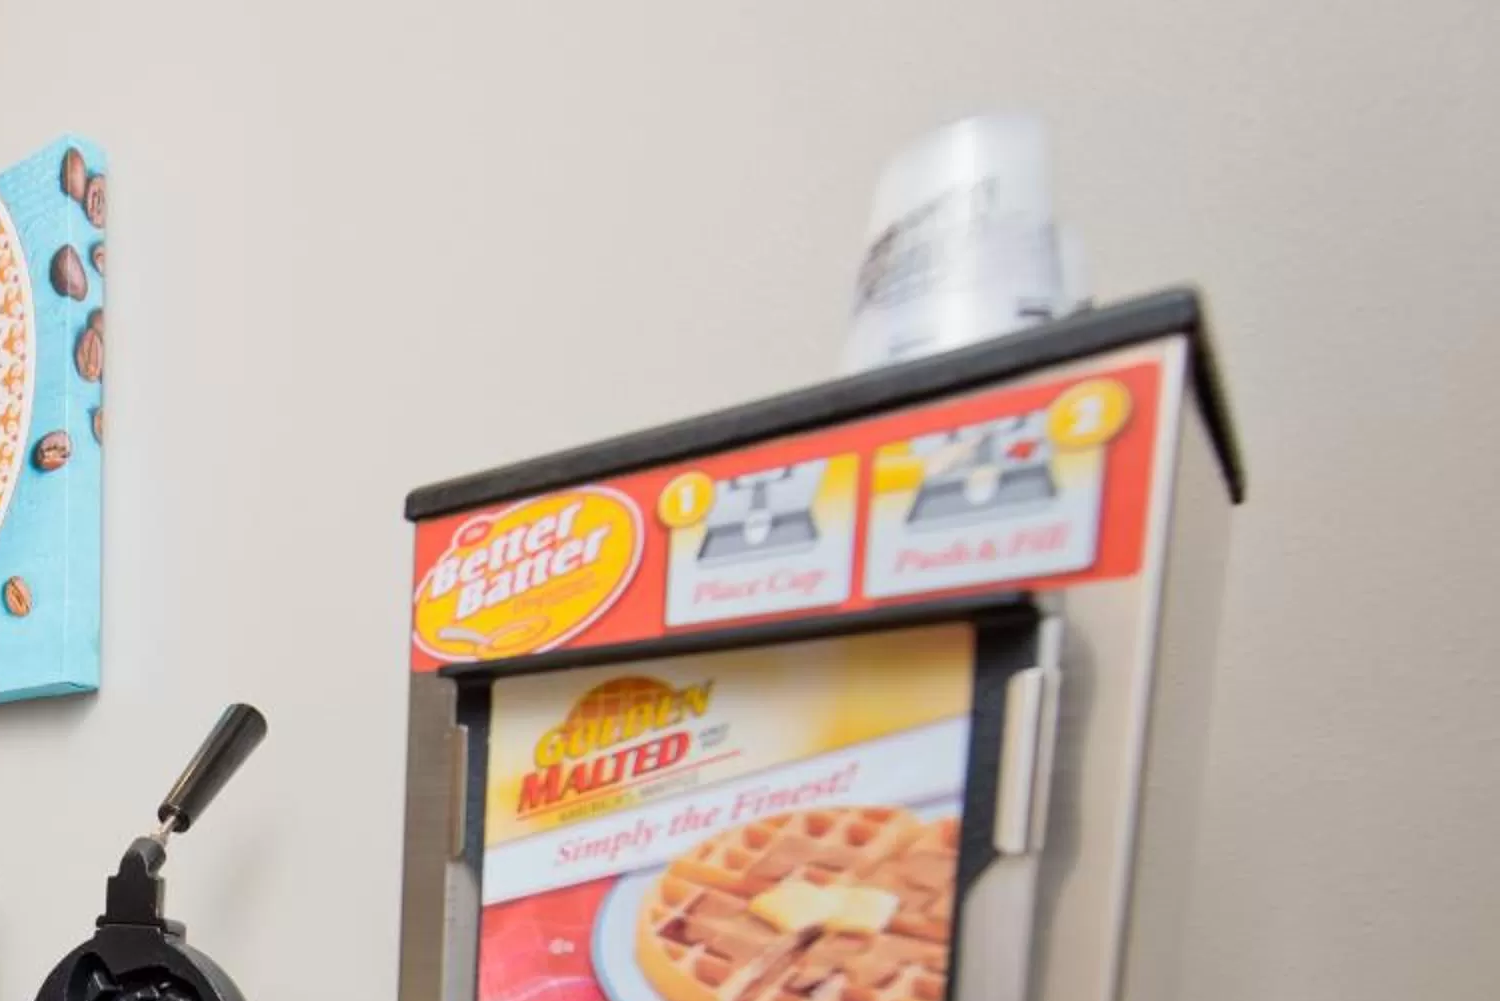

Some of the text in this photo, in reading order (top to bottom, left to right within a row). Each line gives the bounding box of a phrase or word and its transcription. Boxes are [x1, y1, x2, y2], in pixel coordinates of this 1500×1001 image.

[678, 482, 695, 516] 1
[429, 500, 584, 599] Better
[456, 524, 612, 620] Batter
[533, 675, 716, 769] GOLDEN
[517, 731, 692, 813] MALTED
[557, 816, 661, 868] Simply
[668, 803, 723, 837] the
